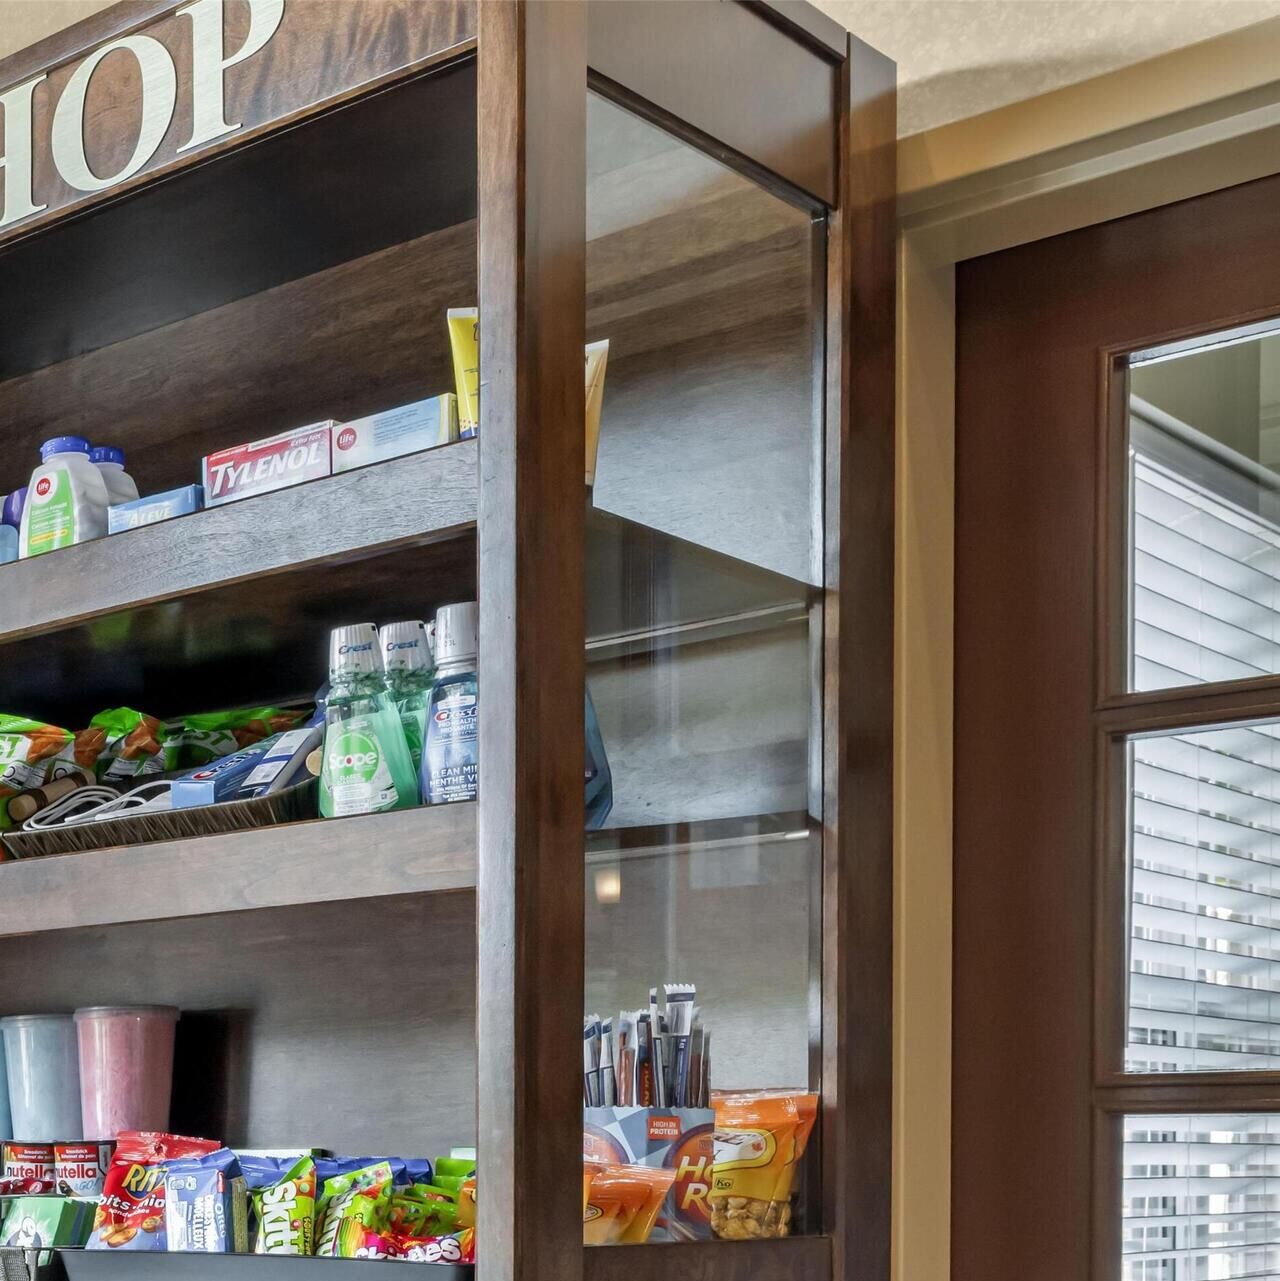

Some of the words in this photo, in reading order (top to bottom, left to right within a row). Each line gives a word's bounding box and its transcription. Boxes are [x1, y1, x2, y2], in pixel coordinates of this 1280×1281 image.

[339, 432, 354, 446] Life
[210, 443, 320, 496] TYLENOL
[338, 641, 373, 655] Crest
[386, 639, 419, 652] Crest
[329, 751, 378, 771] Scope
[432, 767, 460, 778] CLEAN
[430, 776, 465, 787] MENTHE
[653, 1120, 669, 1128] HIGH
[650, 1127, 678, 1136] PROTEIN
[7, 1163, 54, 1178] nutella
[55, 1164, 96, 1178] nutella
[122, 1164, 169, 1192] RITZ
[99, 1194, 130, 1209] bits
[215, 1203, 226, 1238] OREO
